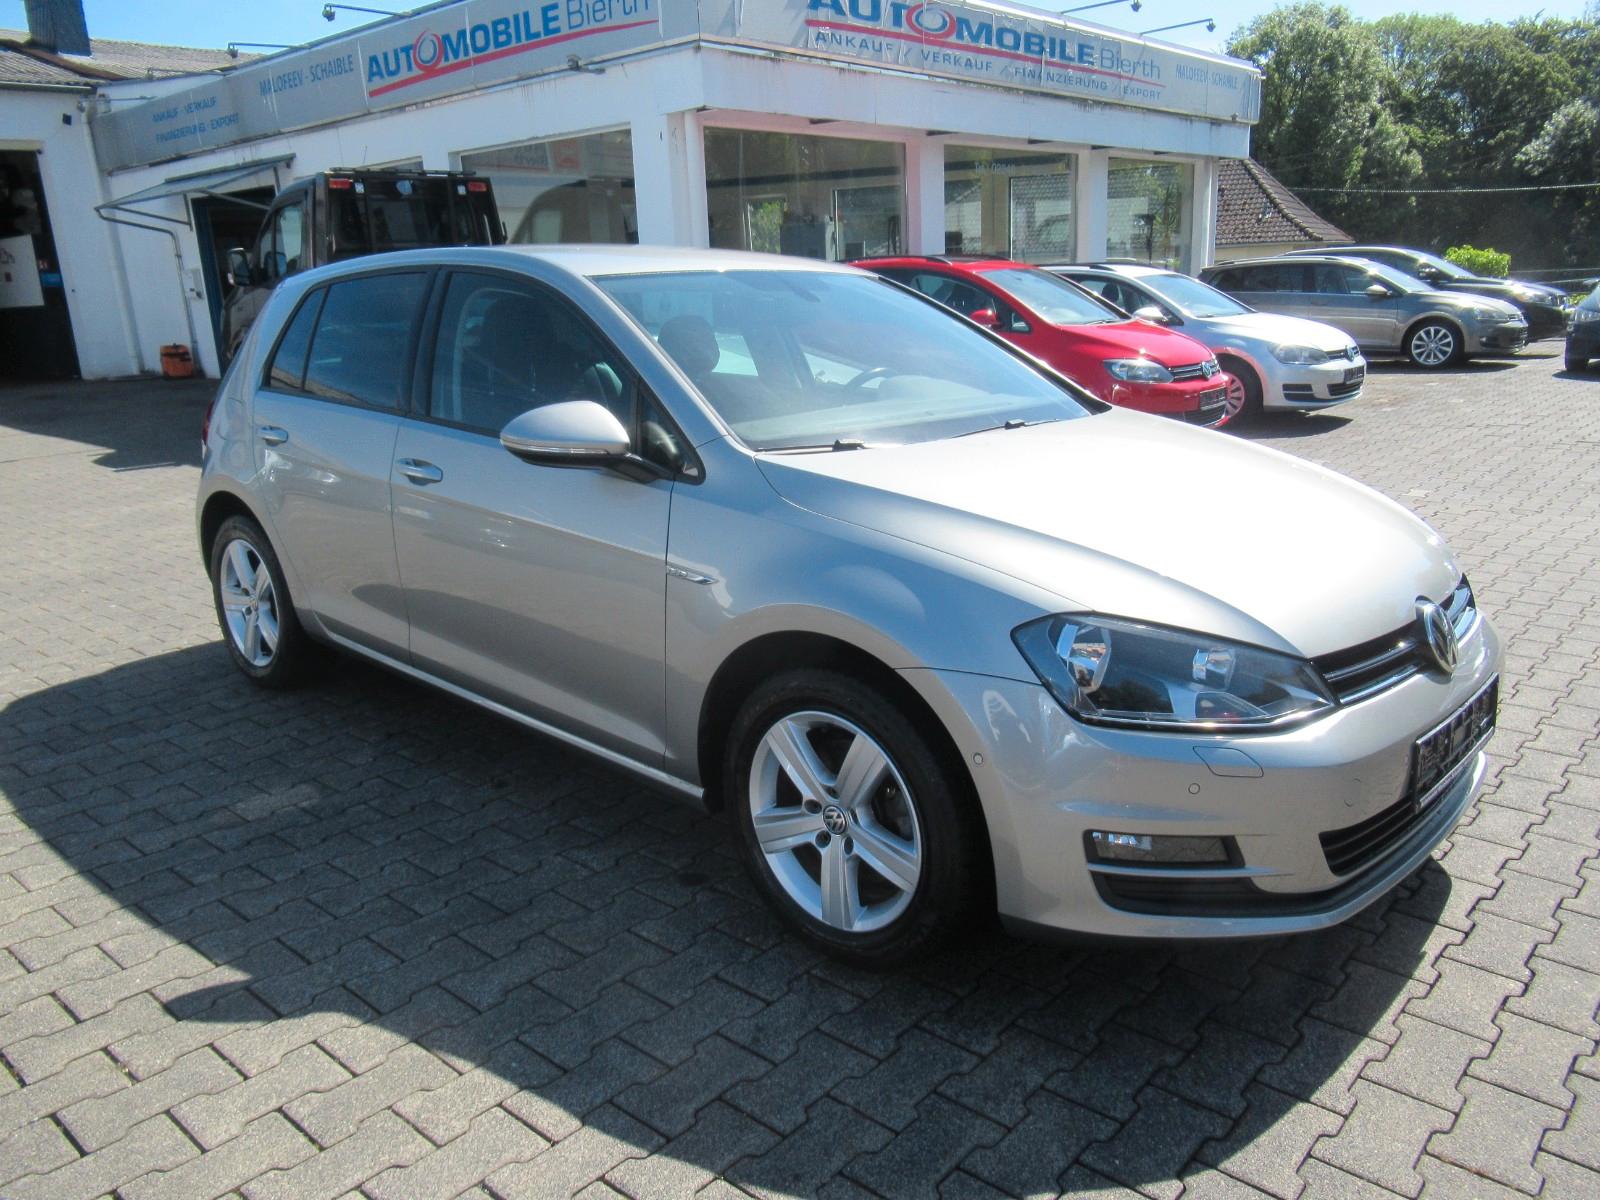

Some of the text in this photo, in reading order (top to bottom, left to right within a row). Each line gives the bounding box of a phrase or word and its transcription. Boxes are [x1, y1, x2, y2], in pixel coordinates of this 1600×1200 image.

[309, 55, 354, 83] SCHAIBLE
[368, 3, 561, 82] AUTOMOBILE
[807, 0, 1161, 80] AUTOMOBILE Bierth
[815, 31, 894, 53] ANKAUF
[920, 50, 993, 72] VERKAUF
[1122, 85, 1161, 100] EXPORT
